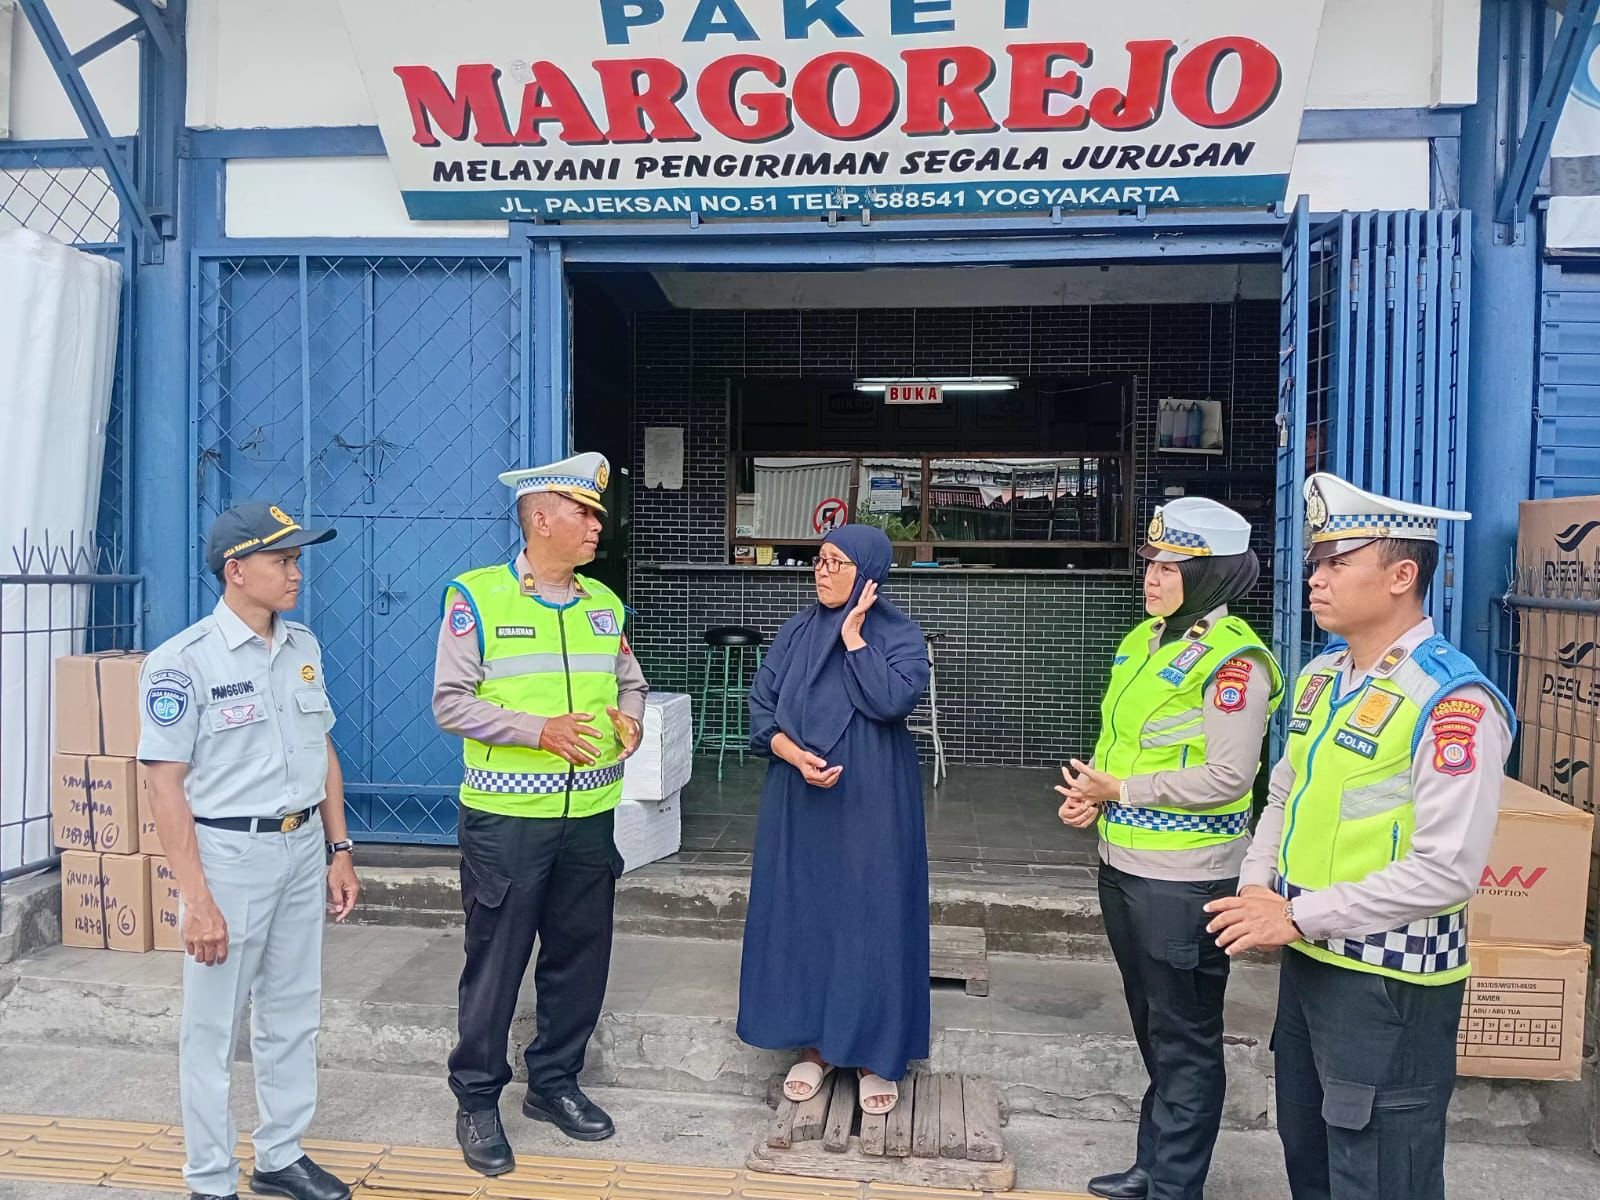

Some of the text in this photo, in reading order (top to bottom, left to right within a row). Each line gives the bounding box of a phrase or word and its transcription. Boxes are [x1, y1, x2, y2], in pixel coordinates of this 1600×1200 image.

[393, 36, 1282, 147] MARGOREJO
[432, 141, 1256, 183] MELAYANI PENGIRIMAN SEGALA JURUSAN
[500, 186, 1180, 214] JL. PAJEKSAN NO.51 TELP. 588541 YOGYAKARTA
[889, 386, 937, 400] BUKA
[211, 680, 255, 700] PANGGUNG
[1336, 731, 1373, 754] POLRI
[1488, 889, 1529, 897] OPTION
